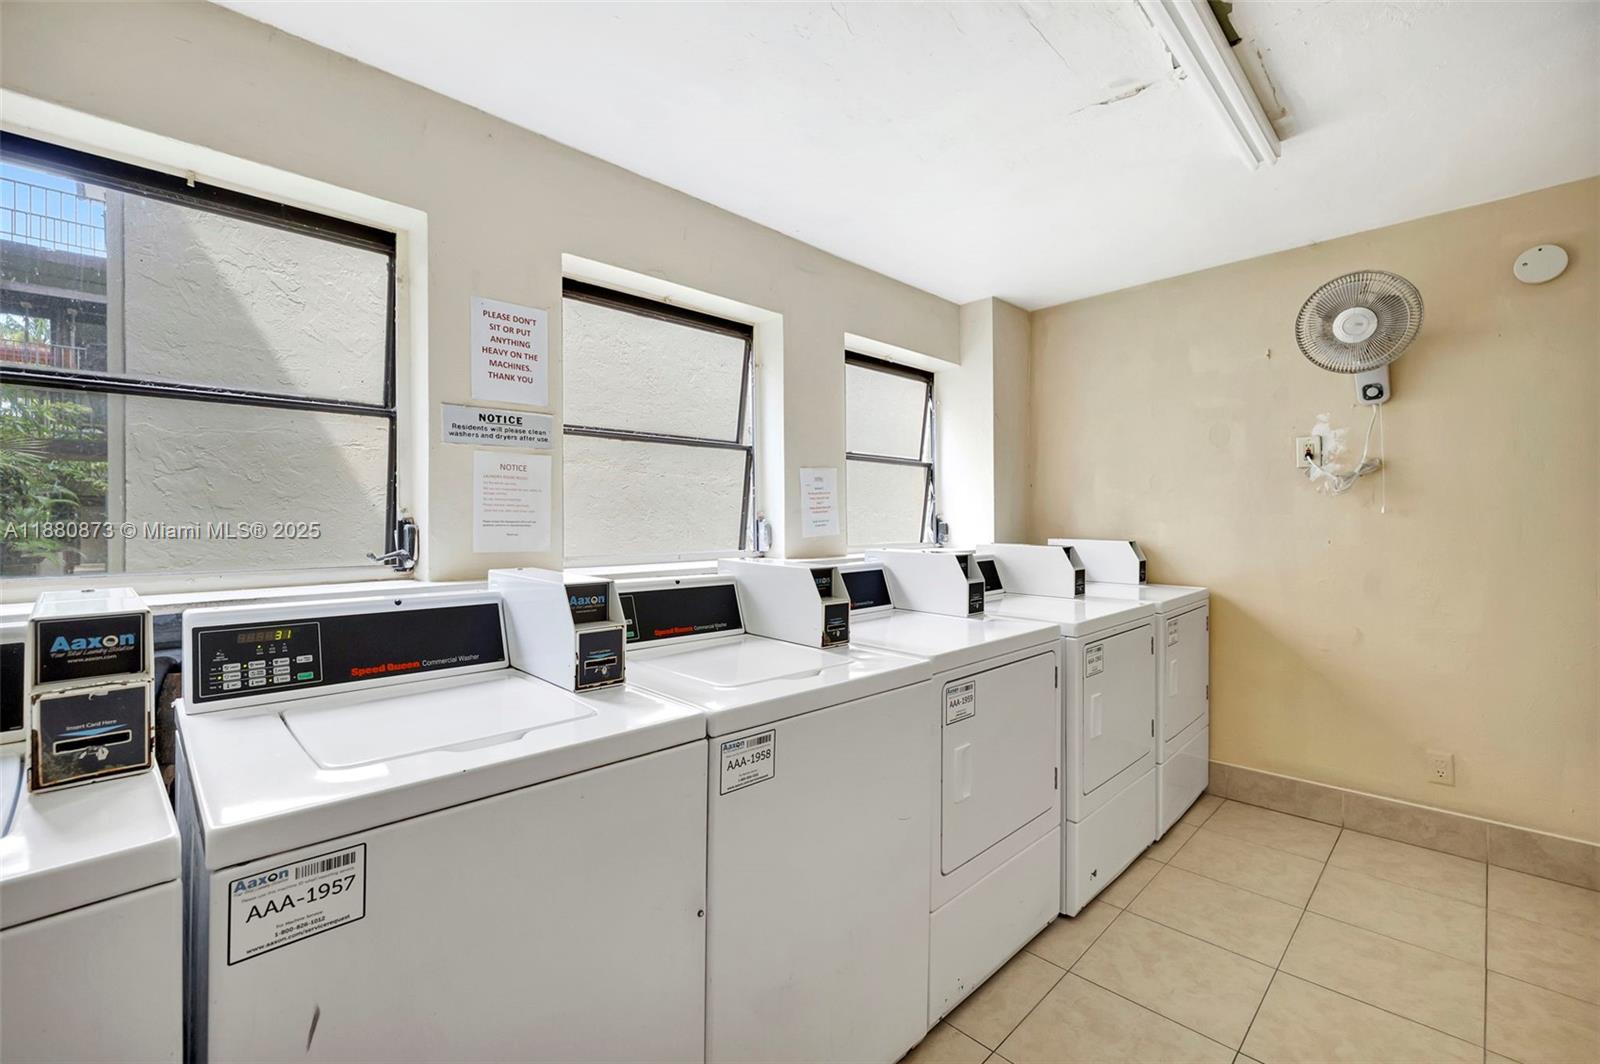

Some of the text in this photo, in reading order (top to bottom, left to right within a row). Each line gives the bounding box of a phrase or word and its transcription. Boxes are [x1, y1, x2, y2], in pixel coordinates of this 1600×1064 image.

[483, 310, 536, 326] PLEASE DON'T
[490, 323, 500, 331] SIT
[502, 326, 514, 334] OR
[490, 336, 530, 348] ANYTHING
[482, 346, 508, 356] HEAVY
[489, 360, 532, 372] MACHINES.
[488, 371, 533, 384] THANK YOU
[478, 413, 522, 424] NOTICE
[452, 423, 488, 432] Residents
[505, 427, 526, 435] please
[500, 464, 527, 472] NOTICE
[570, 595, 605, 606] Aaxon
[50, 633, 135, 653] Aaxon
[351, 654, 480, 676] Speed Queen Commercial Washer
[723, 740, 745, 751] Aaxon
[727, 748, 771, 772] AAA-1958
[234, 869, 289, 893] Aaxon
[246, 874, 356, 924] AAA-1957
